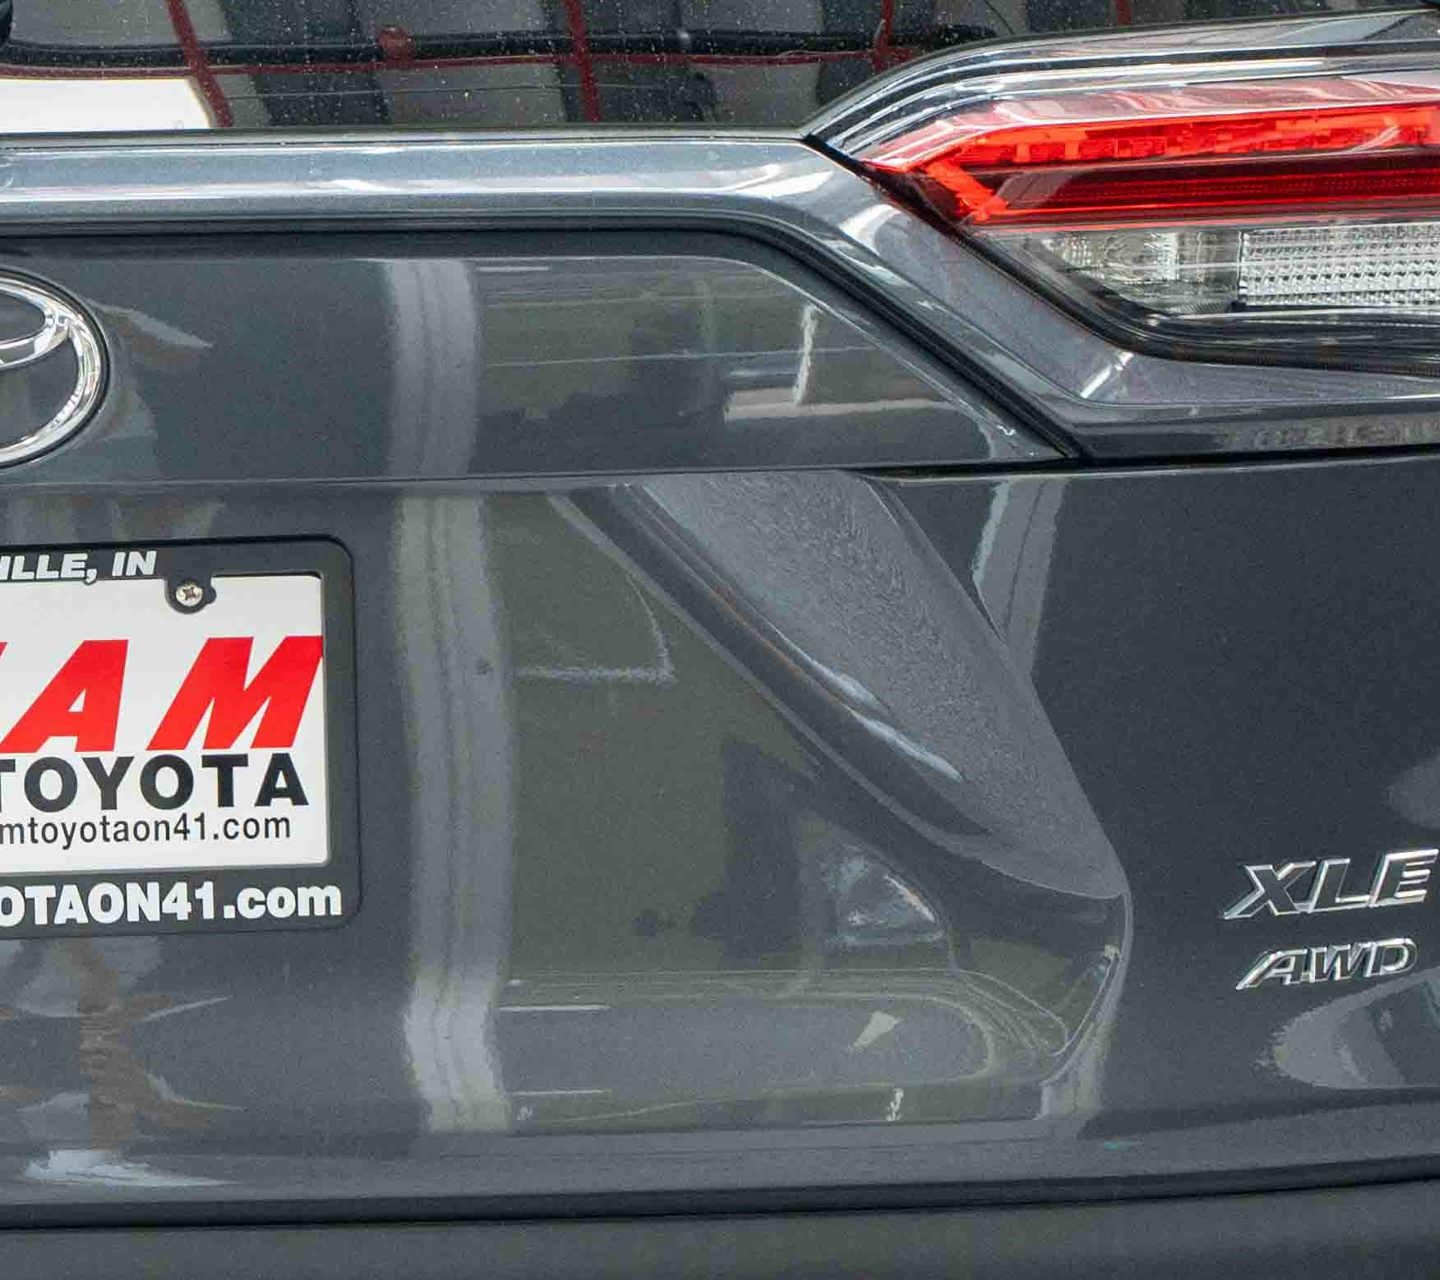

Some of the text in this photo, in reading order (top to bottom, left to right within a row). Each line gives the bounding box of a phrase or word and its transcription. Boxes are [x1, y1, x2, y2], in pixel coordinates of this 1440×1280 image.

[111, 551, 157, 579] IN
[1221, 847, 1440, 920] XLE
[1235, 936, 1418, 991] AWD
